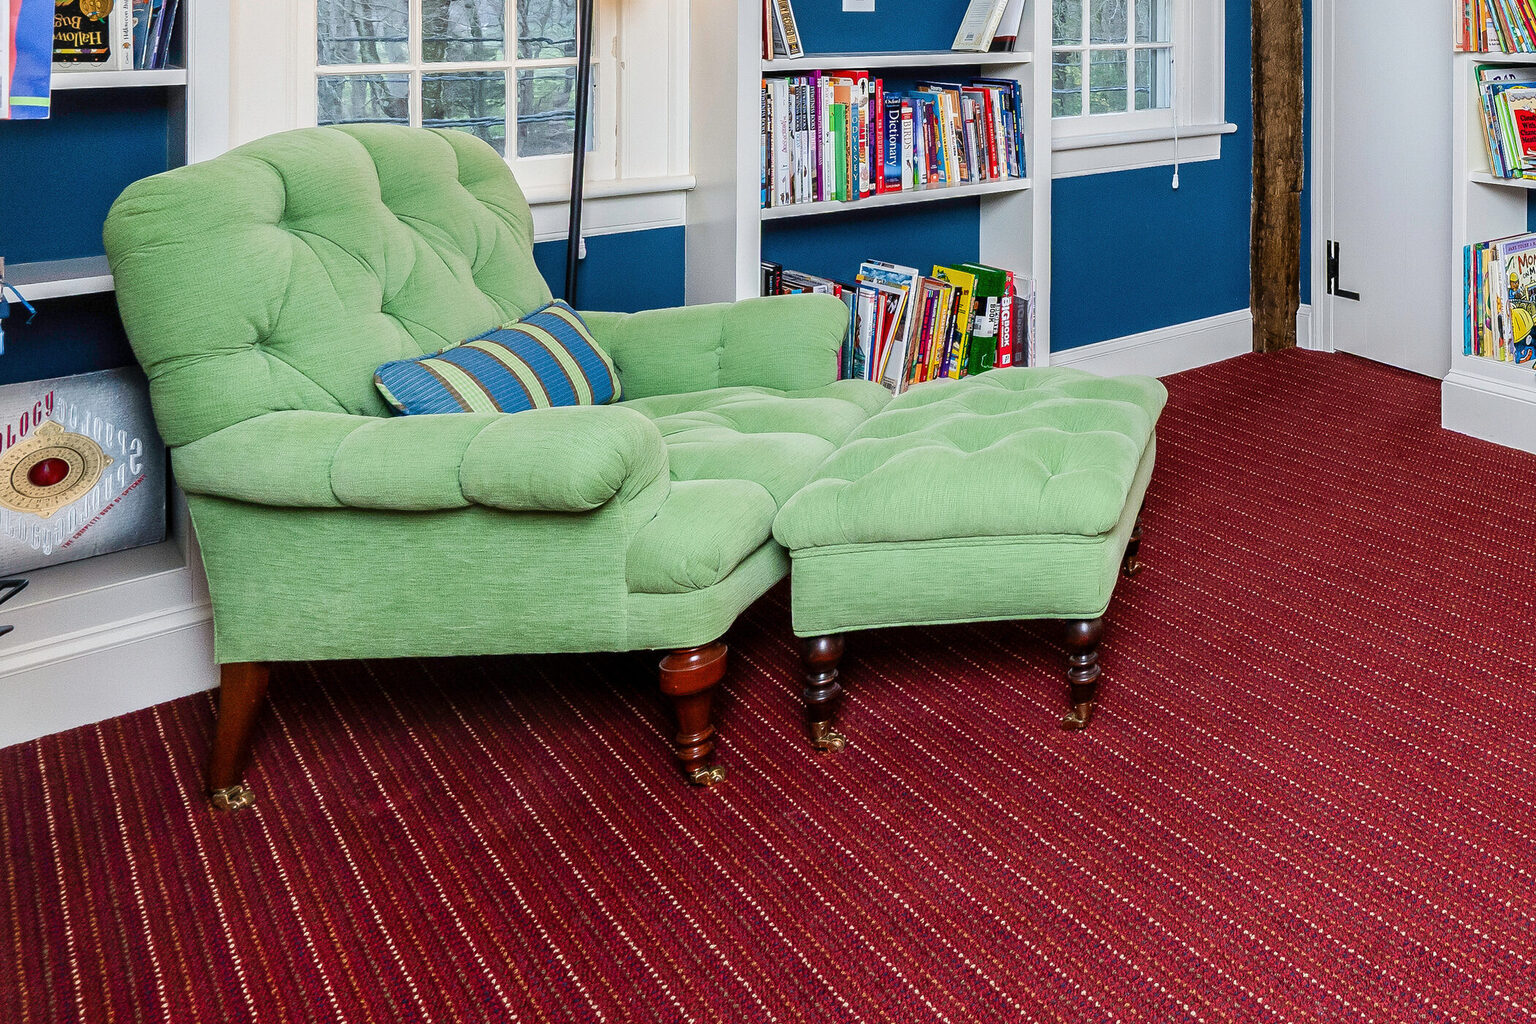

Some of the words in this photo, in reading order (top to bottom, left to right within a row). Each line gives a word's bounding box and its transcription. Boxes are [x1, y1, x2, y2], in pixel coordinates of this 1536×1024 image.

[851, 116, 859, 181] ODYSSEY
[886, 109, 899, 166] Dictionary
[903, 121, 911, 149] BIRDS
[988, 303, 996, 322] BOOK
[1001, 296, 1011, 320] BIG
